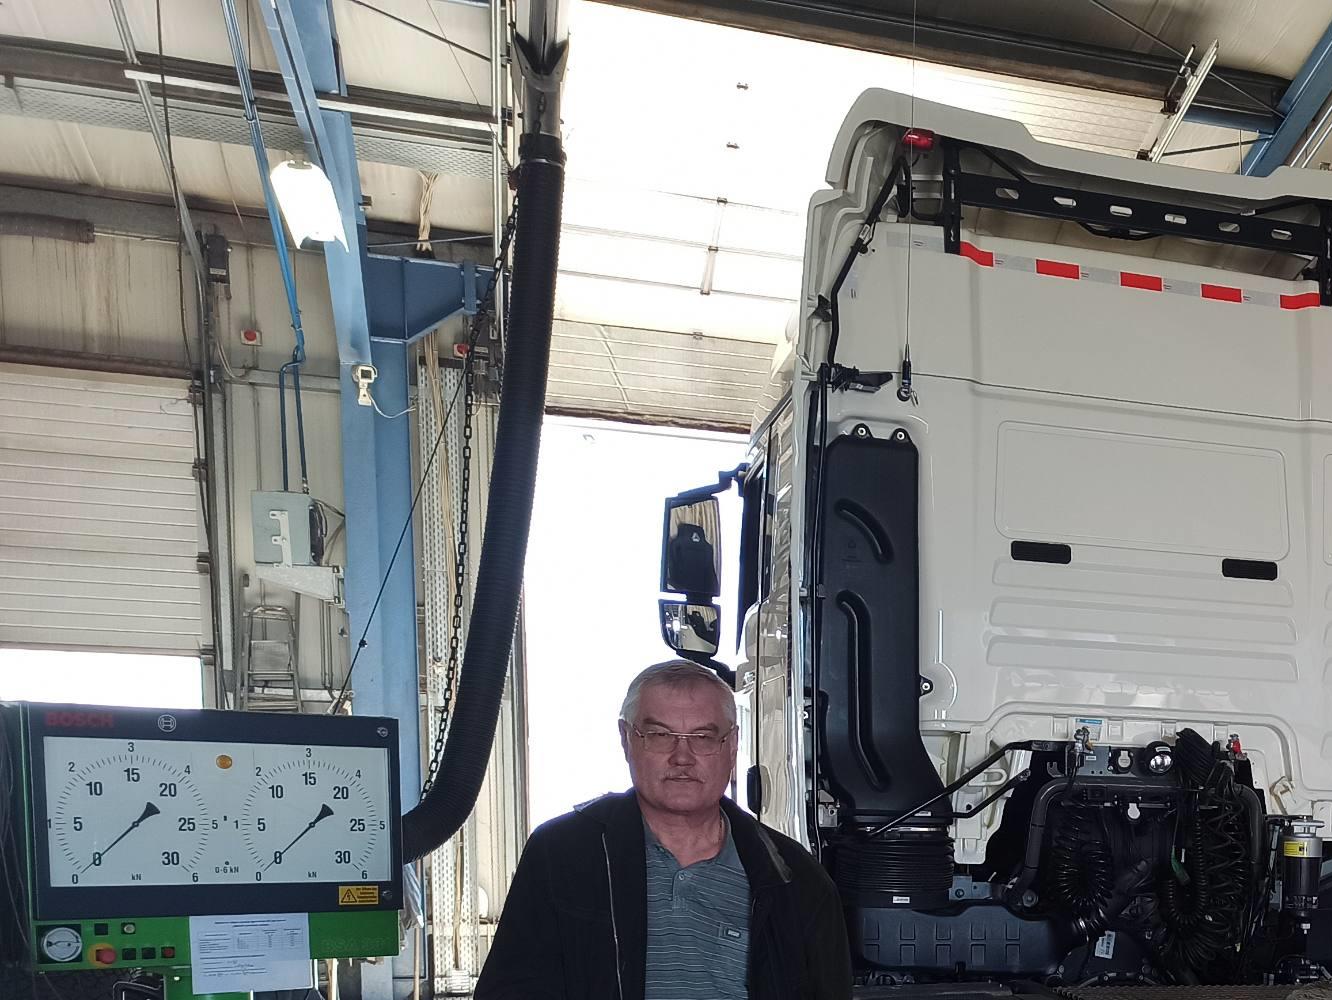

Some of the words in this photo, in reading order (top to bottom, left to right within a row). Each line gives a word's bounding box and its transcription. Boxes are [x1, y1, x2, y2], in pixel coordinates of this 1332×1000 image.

[47, 711, 113, 727] BOSCH
[128, 742, 134, 752] 3
[306, 748, 312, 757] 3
[68, 762, 75, 772] 2
[185, 765, 191, 774] 4
[256, 767, 261, 776] 2
[124, 768, 140, 782] 15
[302, 772, 316, 785] 15
[355, 770, 361, 778] 4
[86, 782, 102, 796] 10
[159, 783, 177, 797] 20
[269, 785, 283, 798] 10
[333, 786, 349, 799] 20
[74, 817, 82, 831] 5
[179, 818, 196, 831] 25
[212, 820, 218, 829] 5
[234, 820, 238, 829] 1
[258, 818, 265, 831] 5
[350, 819, 365, 831] 25
[379, 821, 385, 829] 5
[162, 852, 179, 865] 30
[335, 851, 350, 863] 30
[72, 874, 78, 884] 0
[192, 873, 198, 882] 6
[256, 872, 262, 881] 0
[362, 871, 367, 879] 6
